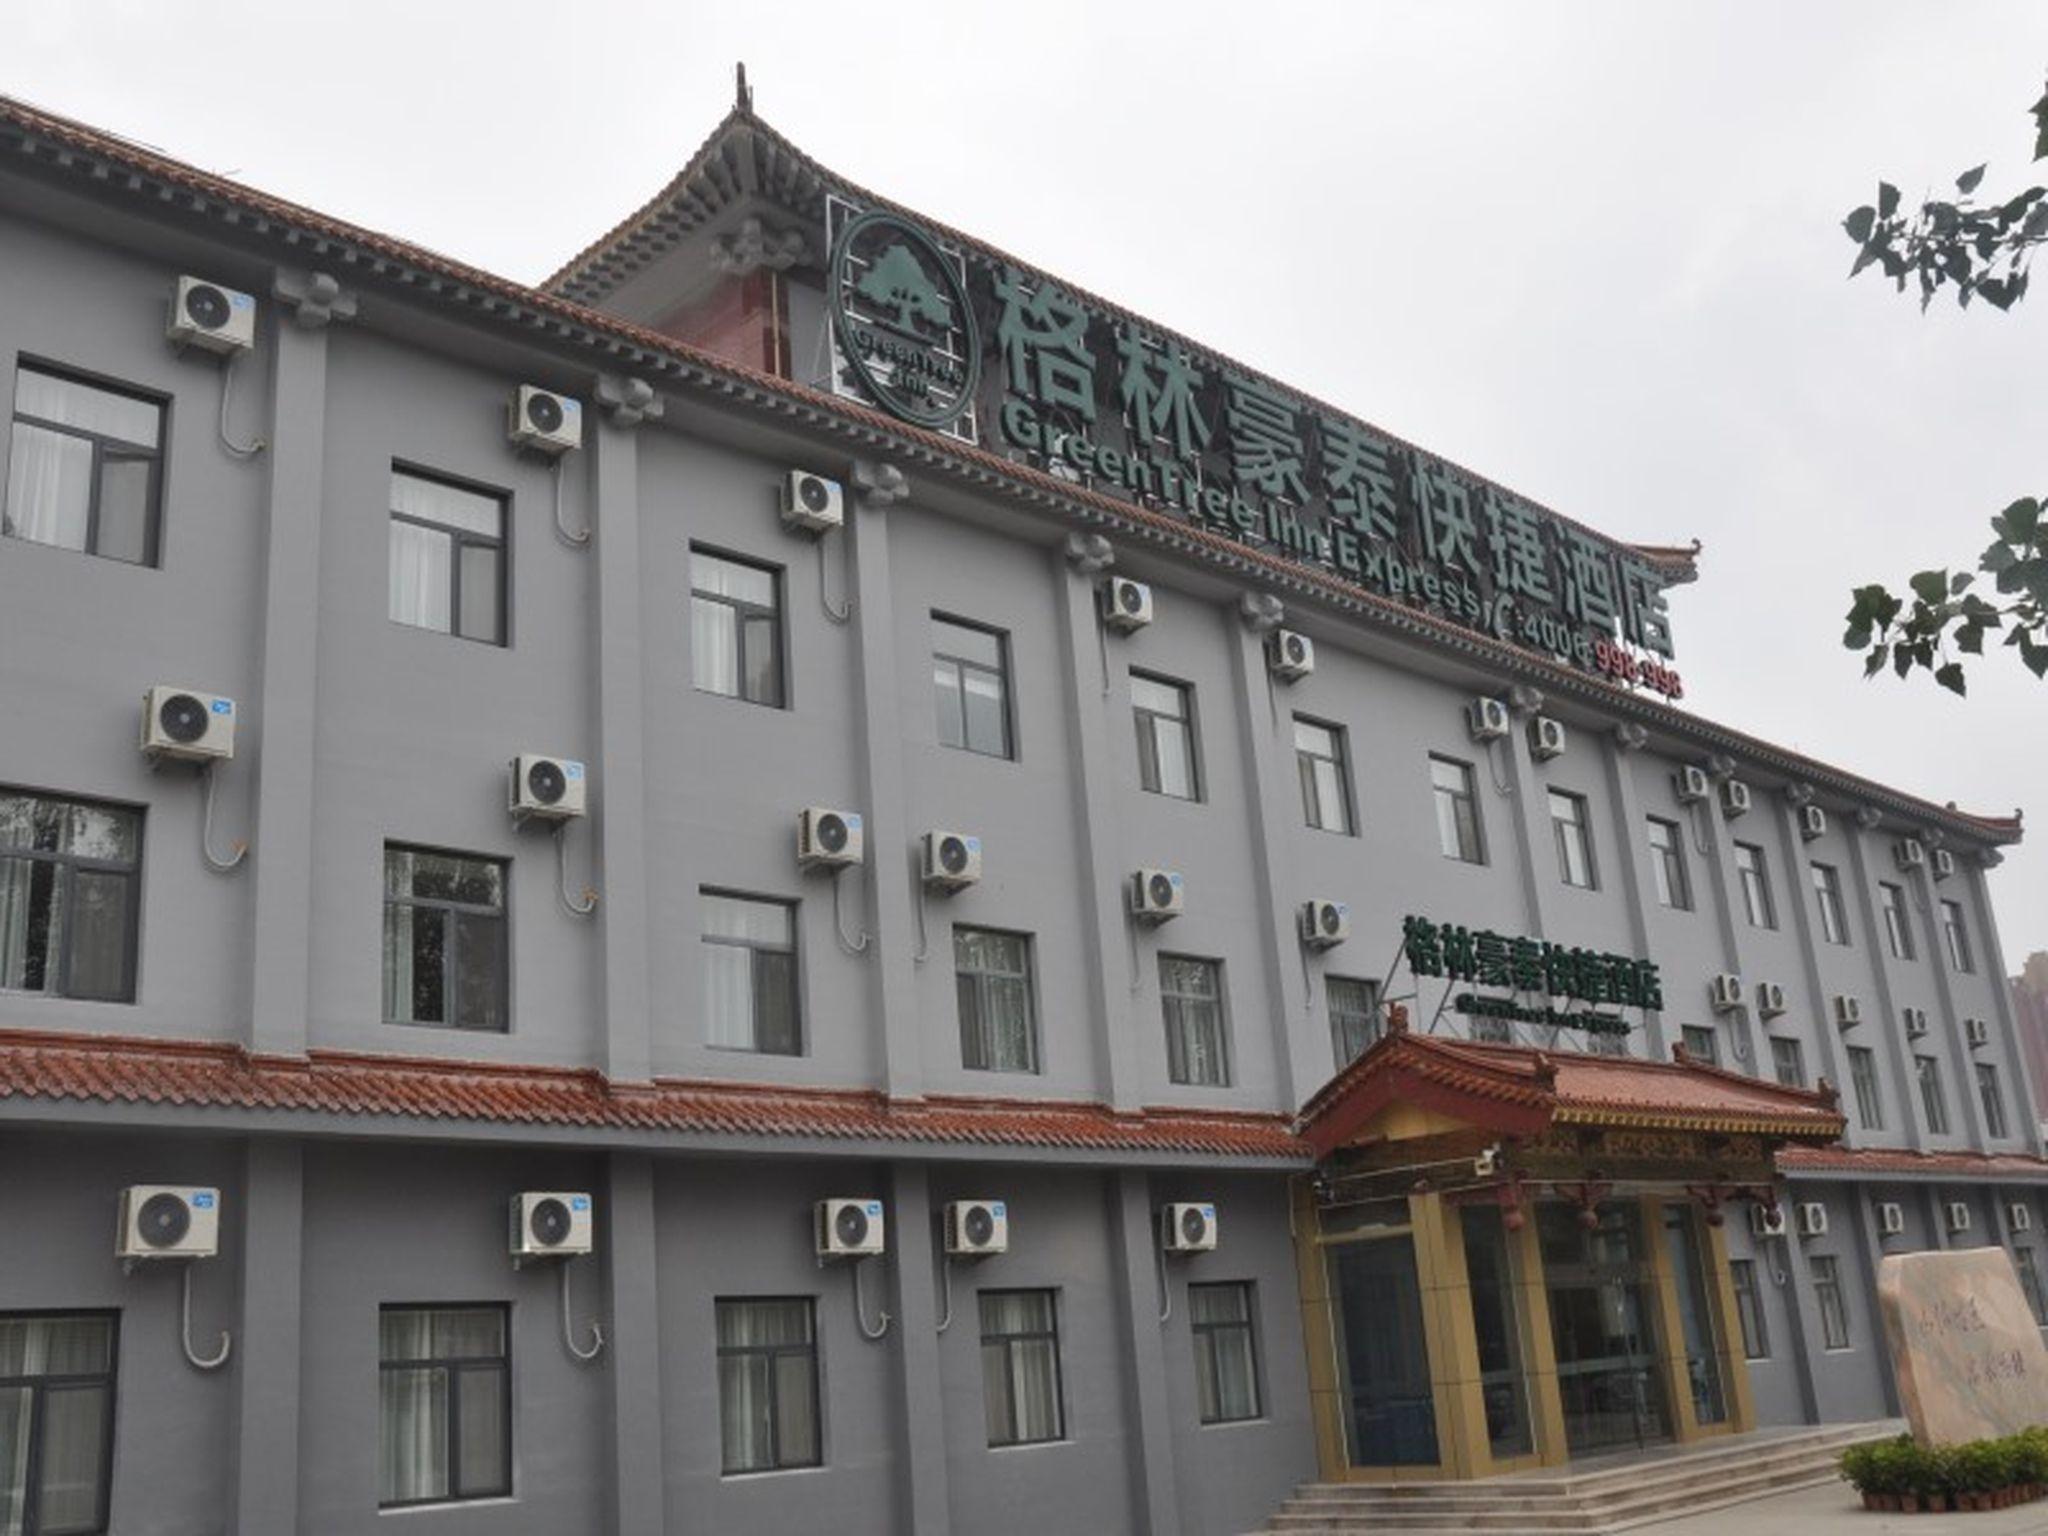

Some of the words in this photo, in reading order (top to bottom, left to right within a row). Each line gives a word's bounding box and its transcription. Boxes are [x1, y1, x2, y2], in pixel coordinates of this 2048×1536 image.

[995, 262, 1676, 658] 格林豪泰快捷酒店
[1003, 402, 1255, 527] GreenTree
[1268, 501, 1331, 557] Inn
[1336, 530, 1480, 617] Express
